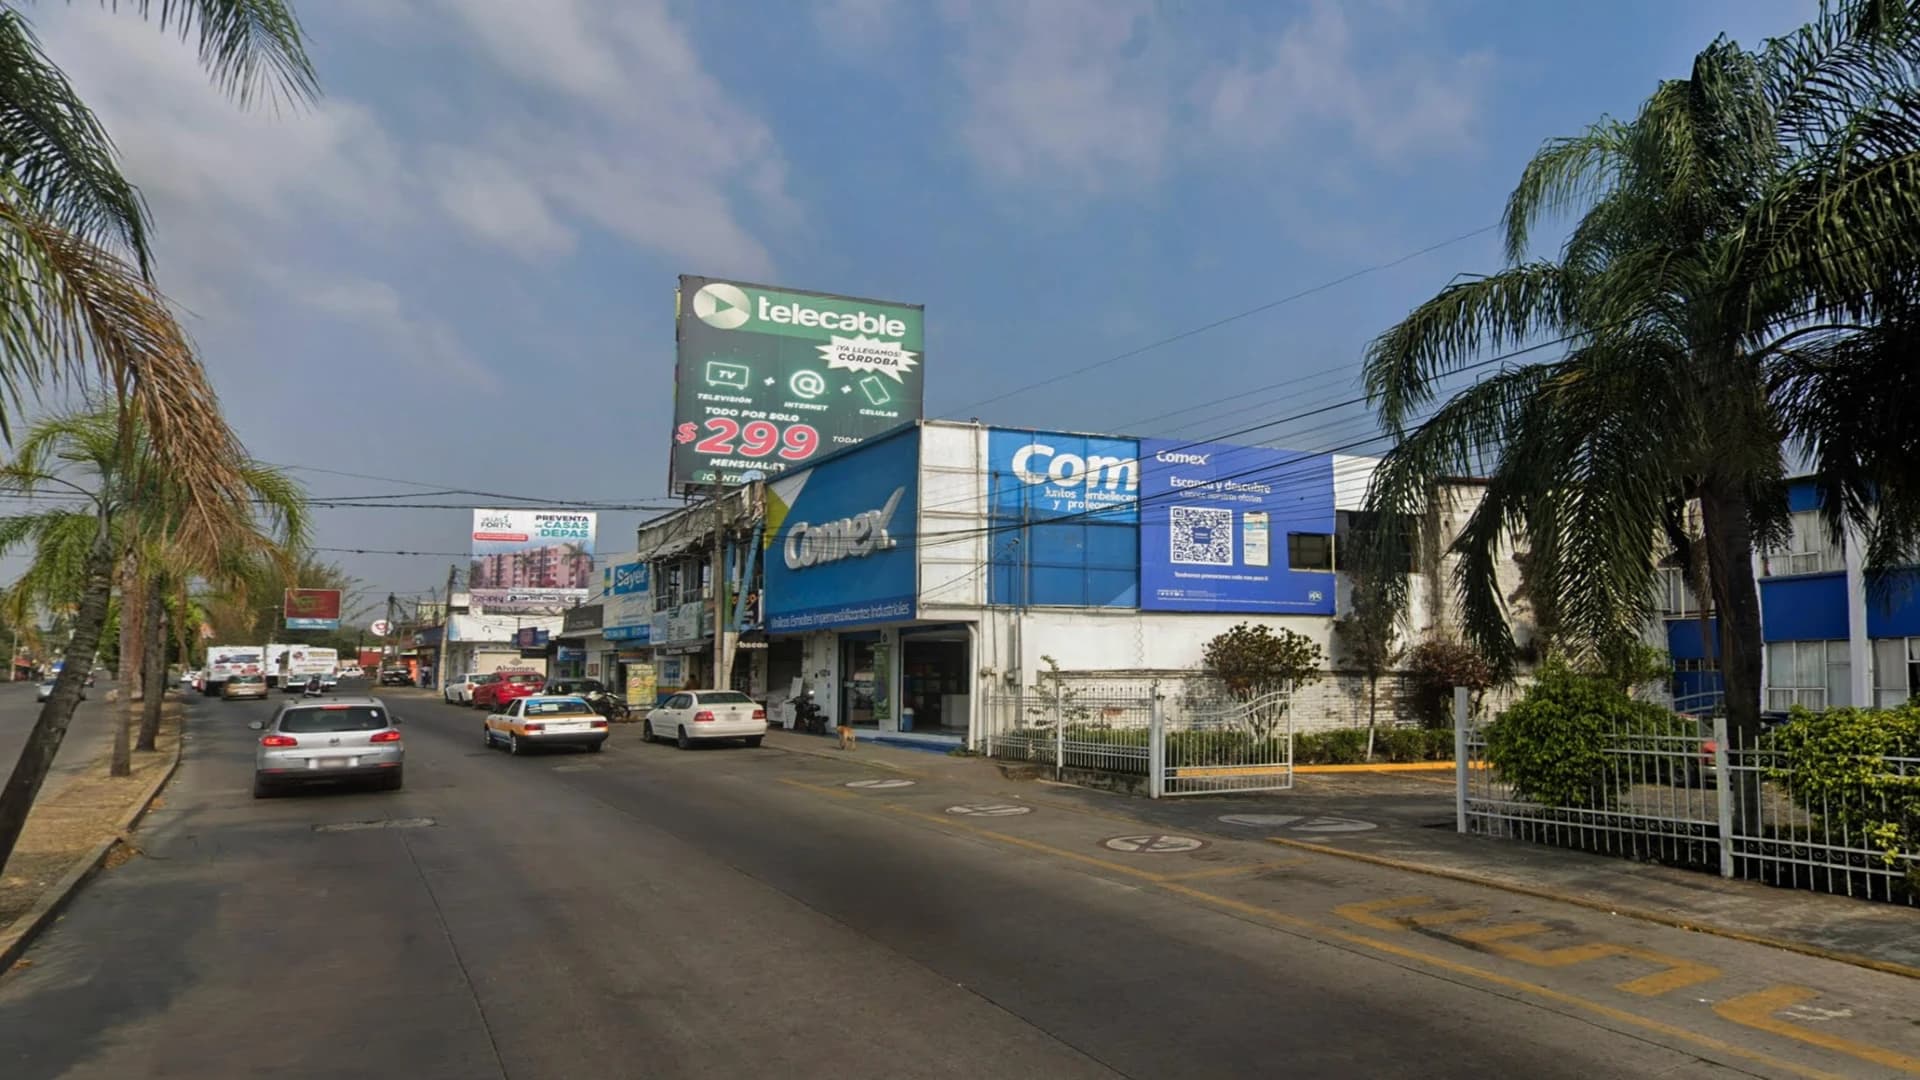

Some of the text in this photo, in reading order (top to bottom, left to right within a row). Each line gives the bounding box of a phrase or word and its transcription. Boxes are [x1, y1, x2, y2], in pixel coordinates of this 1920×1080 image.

[758, 296, 906, 337] telecable
[836, 344, 902, 358] ¡YA LLEGAMOS!
[719, 370, 736, 379] TV
[697, 393, 752, 404] TELEVISIÓN
[784, 401, 829, 411] INTERNET
[704, 406, 800, 422] TODO POR SOLO
[859, 408, 898, 417] CELULAR
[676, 416, 819, 461] $299
[1156, 449, 1211, 465] Comex
[1044, 487, 1077, 499] Juntos
[1215, 481, 1223, 492] y
[1224, 480, 1272, 494] descubre
[1053, 500, 1060, 510] y
[535, 514, 589, 522] PREVENTA
[543, 521, 589, 529] CASAS
[784, 485, 905, 570] Comex
[540, 529, 589, 538] DEPAS
[617, 568, 646, 590] Sayer
